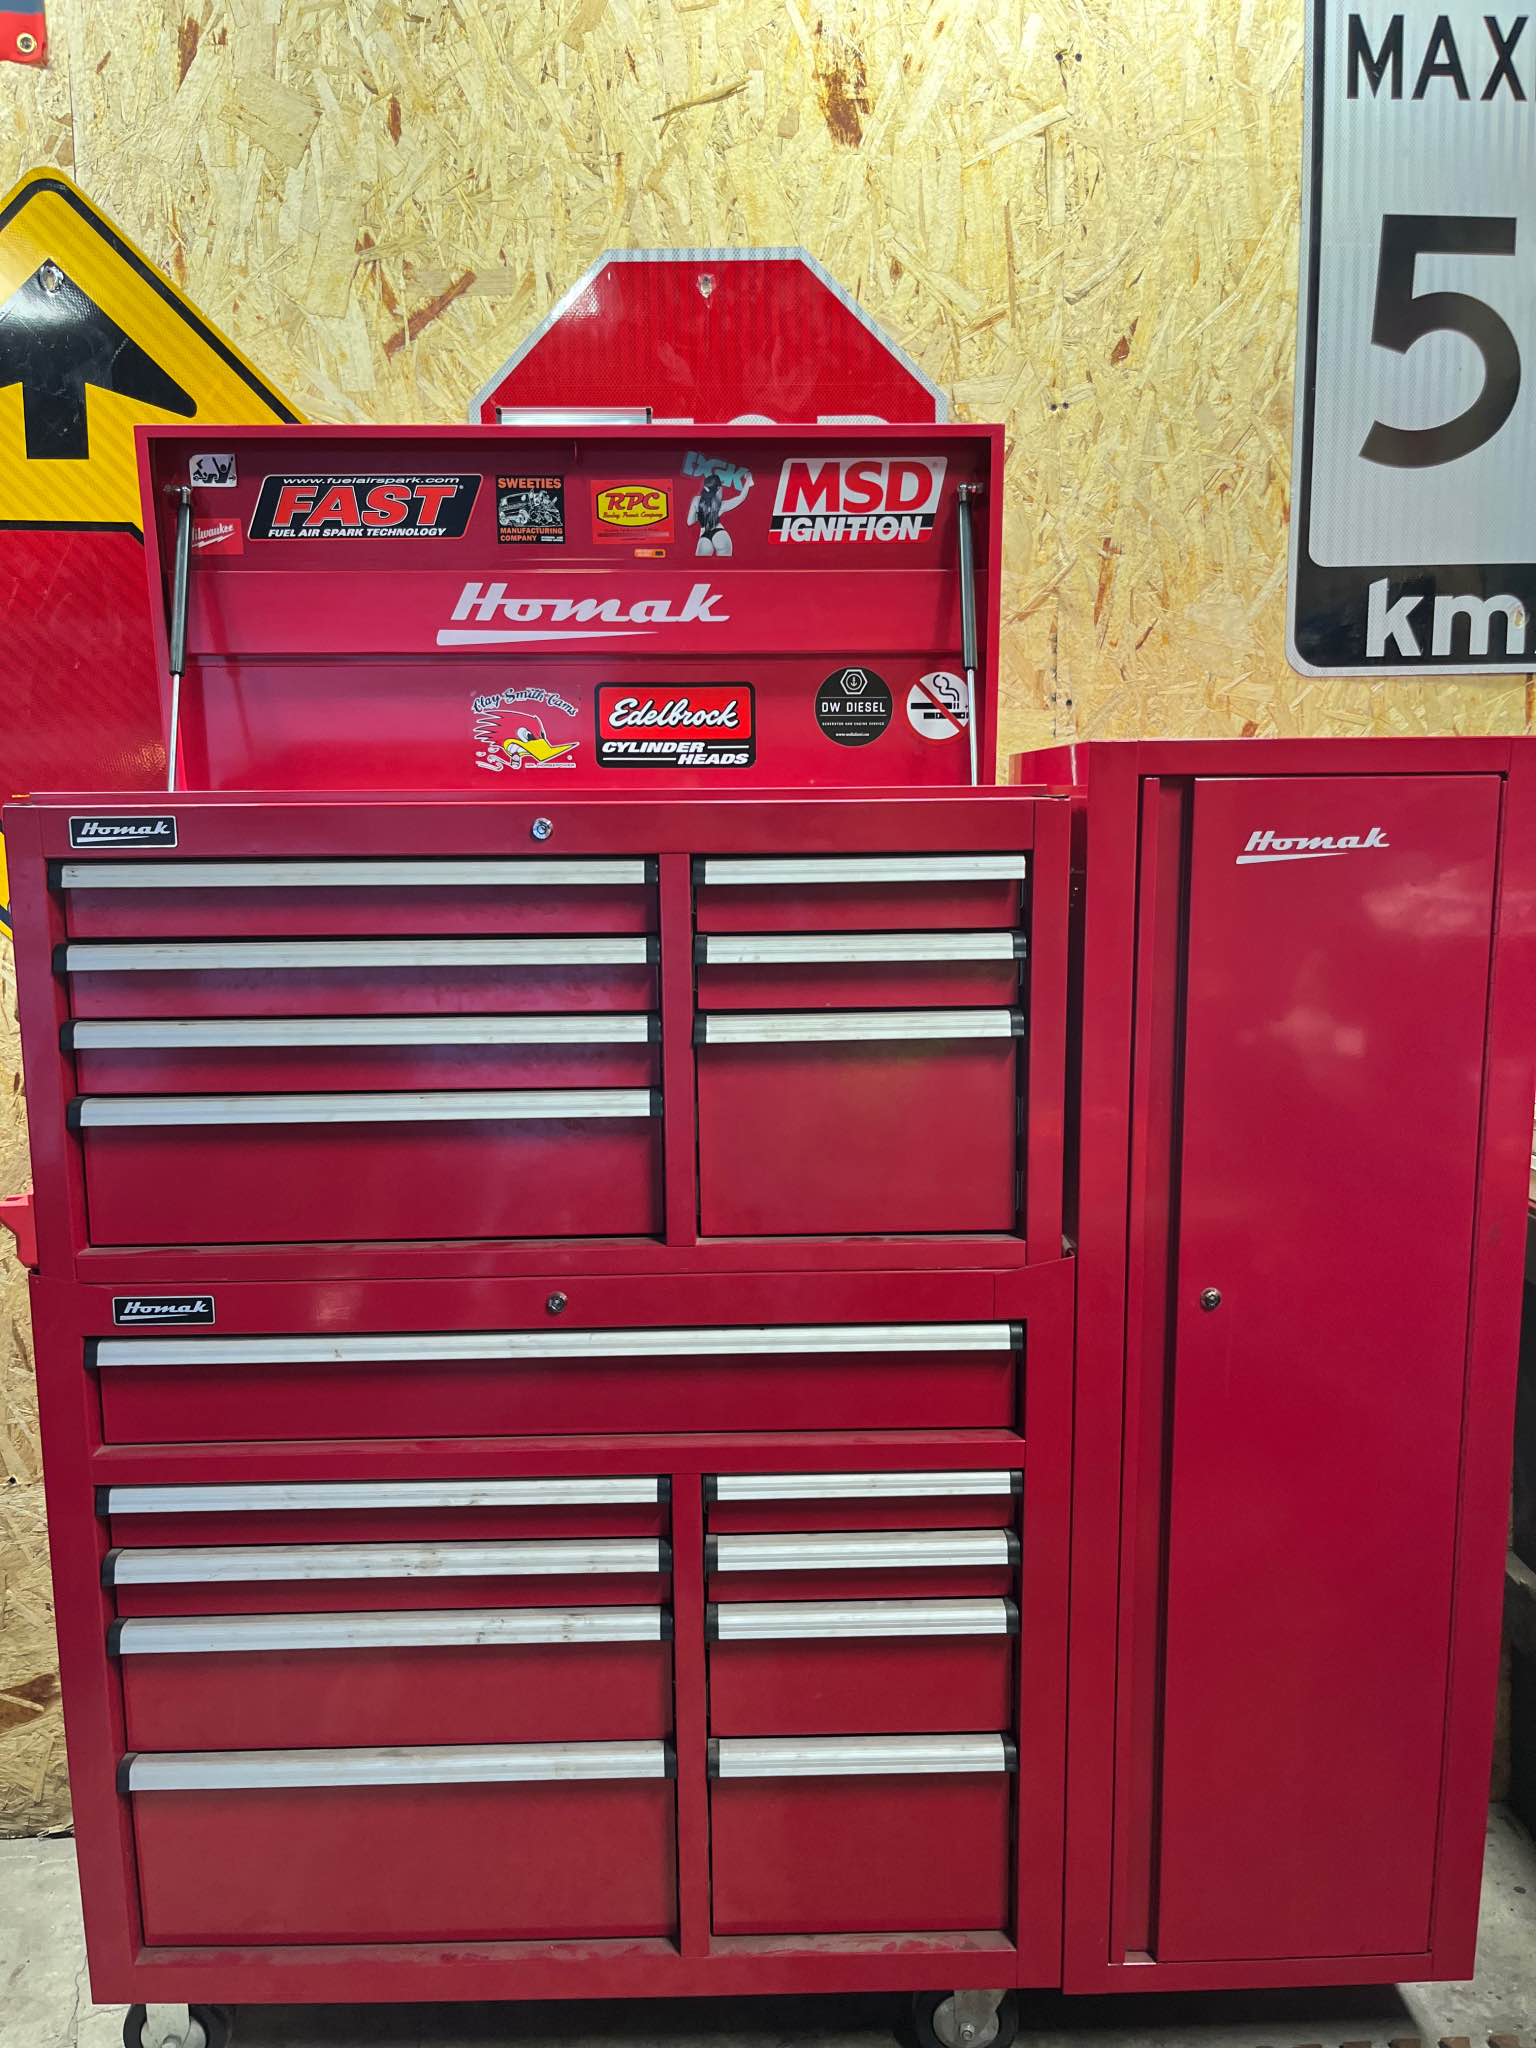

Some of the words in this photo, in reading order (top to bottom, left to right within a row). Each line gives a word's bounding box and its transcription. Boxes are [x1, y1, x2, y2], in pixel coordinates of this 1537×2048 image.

[1358, 213, 1522, 470] 5
[283, 476, 460, 485] www.fuelairspark.com
[497, 477, 562, 489] SWEETIES
[781, 460, 933, 514] MSD
[271, 484, 458, 528] FAST
[605, 492, 660, 511] RPC
[267, 528, 297, 538] FUEL
[298, 528, 320, 538] AIR
[322, 528, 365, 538] SPARK
[366, 527, 448, 537] TECHNOLOGY
[500, 527, 563, 535] MANUFACTURING
[779, 515, 923, 543] IGNITION
[450, 582, 731, 623] Homak
[472, 694, 501, 714] Clay
[502, 687, 547, 704] Smith
[547, 692, 579, 717] Cams
[821, 701, 841, 713] DW
[846, 701, 886, 713] DIESEL
[608, 696, 740, 729] Edelbrock
[601, 741, 706, 754] CYLINDER
[677, 753, 750, 765] HEADS
[81, 821, 171, 835] Homak
[1244, 827, 1391, 852] Homak
[123, 1300, 209, 1314] Homak
